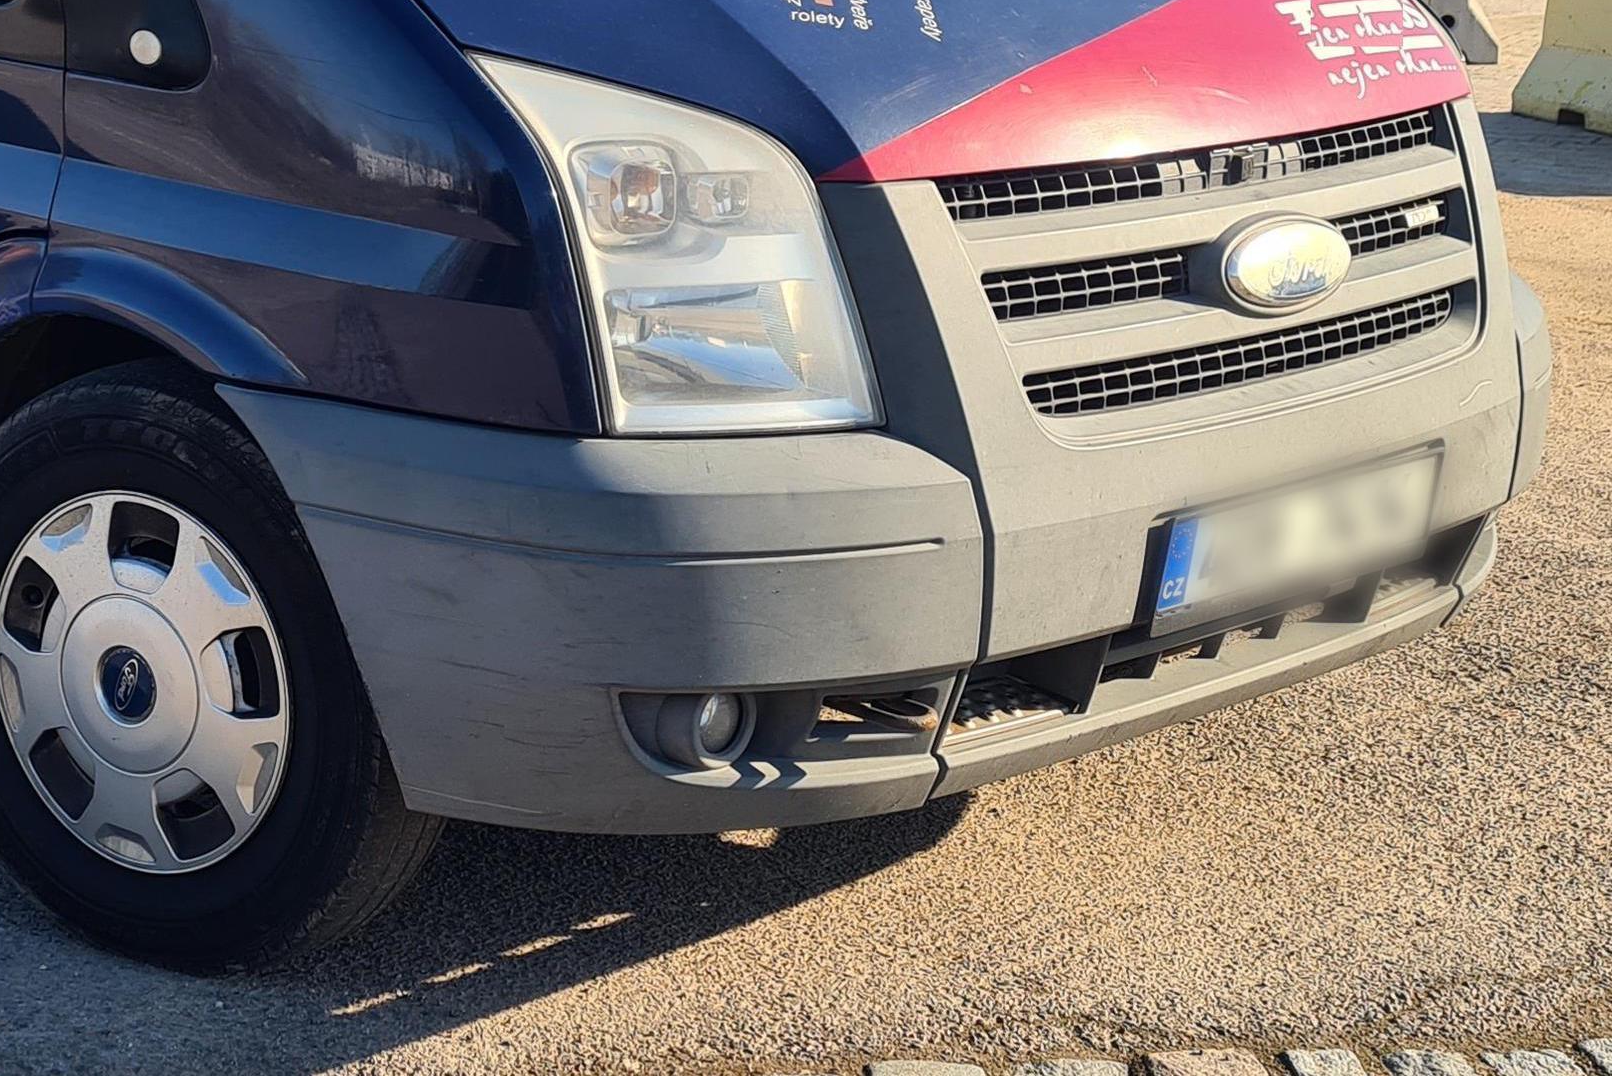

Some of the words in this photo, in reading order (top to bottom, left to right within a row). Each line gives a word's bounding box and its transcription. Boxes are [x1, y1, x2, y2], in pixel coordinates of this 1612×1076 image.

[791, 10, 845, 29] rolety
[1327, 60, 1390, 100] nejen
[1162, 576, 1185, 600] CZ
